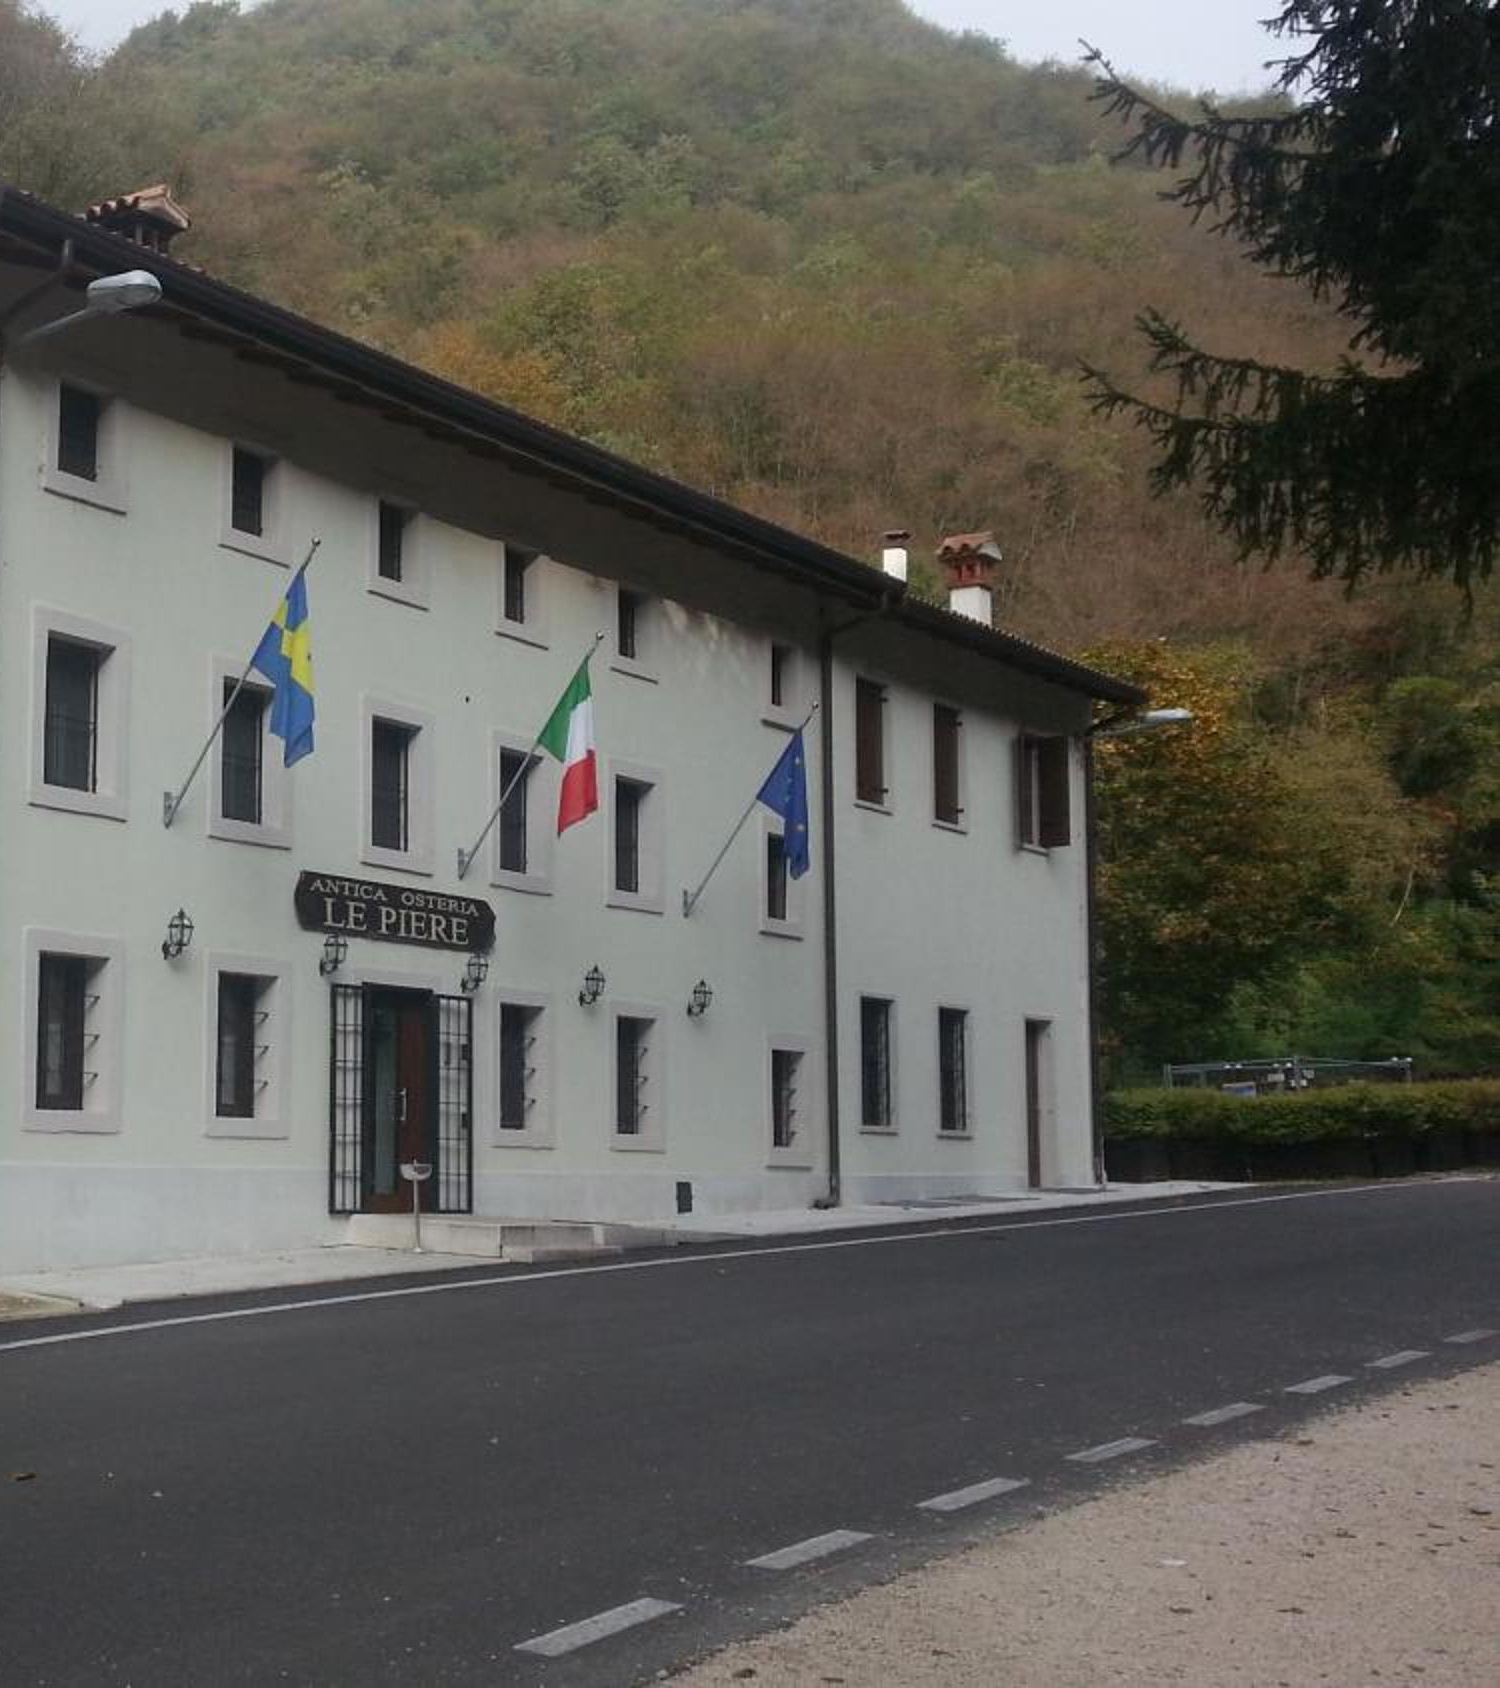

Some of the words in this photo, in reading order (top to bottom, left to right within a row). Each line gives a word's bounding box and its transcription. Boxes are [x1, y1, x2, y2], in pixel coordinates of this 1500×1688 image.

[310, 878, 388, 902] ANTICA
[400, 891, 480, 918] OSTERIA
[323, 897, 368, 931] LE
[378, 905, 469, 946] PIERE
